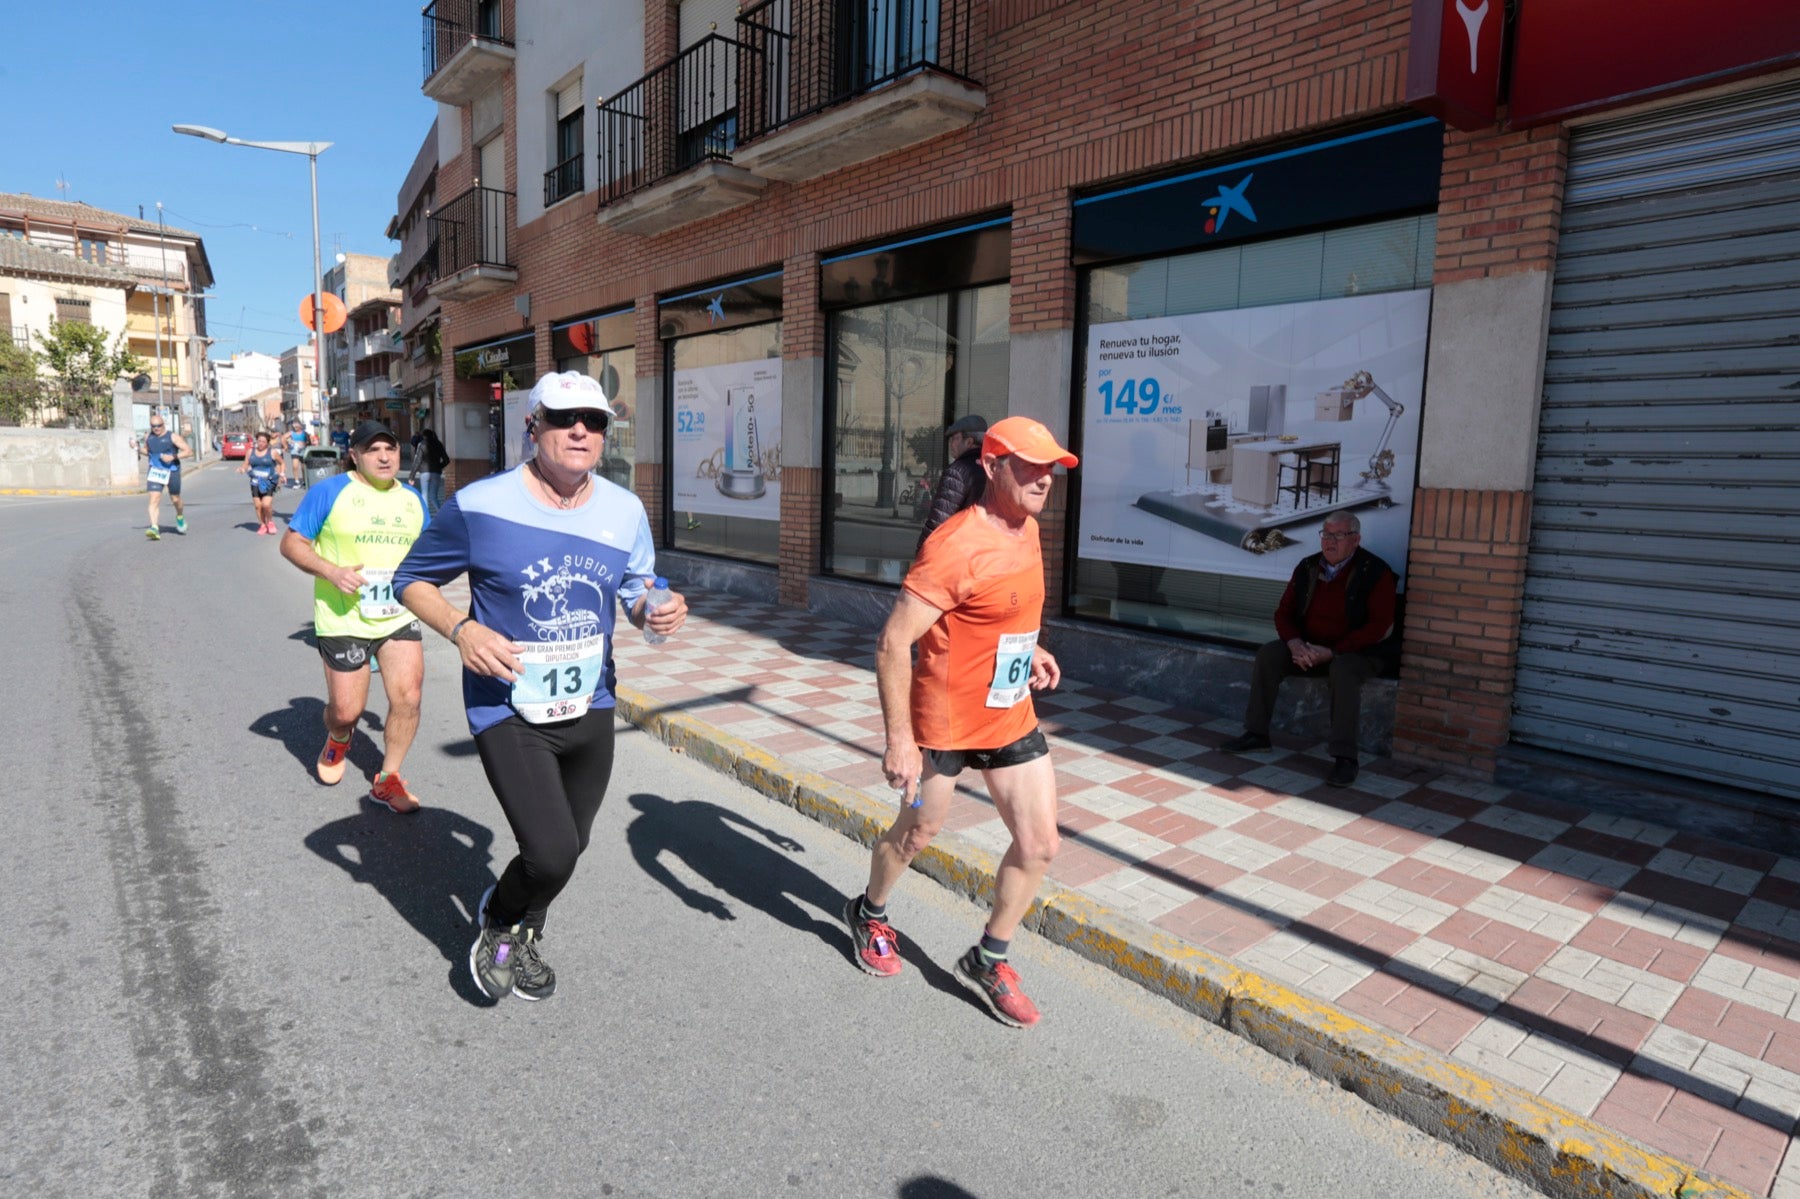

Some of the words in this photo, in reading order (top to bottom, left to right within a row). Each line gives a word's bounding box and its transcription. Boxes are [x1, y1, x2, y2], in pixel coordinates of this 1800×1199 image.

[1100, 338, 1138, 349] Renueva
[1140, 337, 1149, 346] tu
[1151, 334, 1181, 347] hogar,
[1099, 350, 1135, 360] renueva
[1137, 349, 1147, 358] tu
[1148, 345, 1179, 357] ilusión
[1098, 369, 1112, 378] por
[1098, 377, 1160, 415] 149
[1162, 405, 1183, 414] mes
[563, 554, 614, 584] SUBIDA
[542, 666, 582, 697] 13
